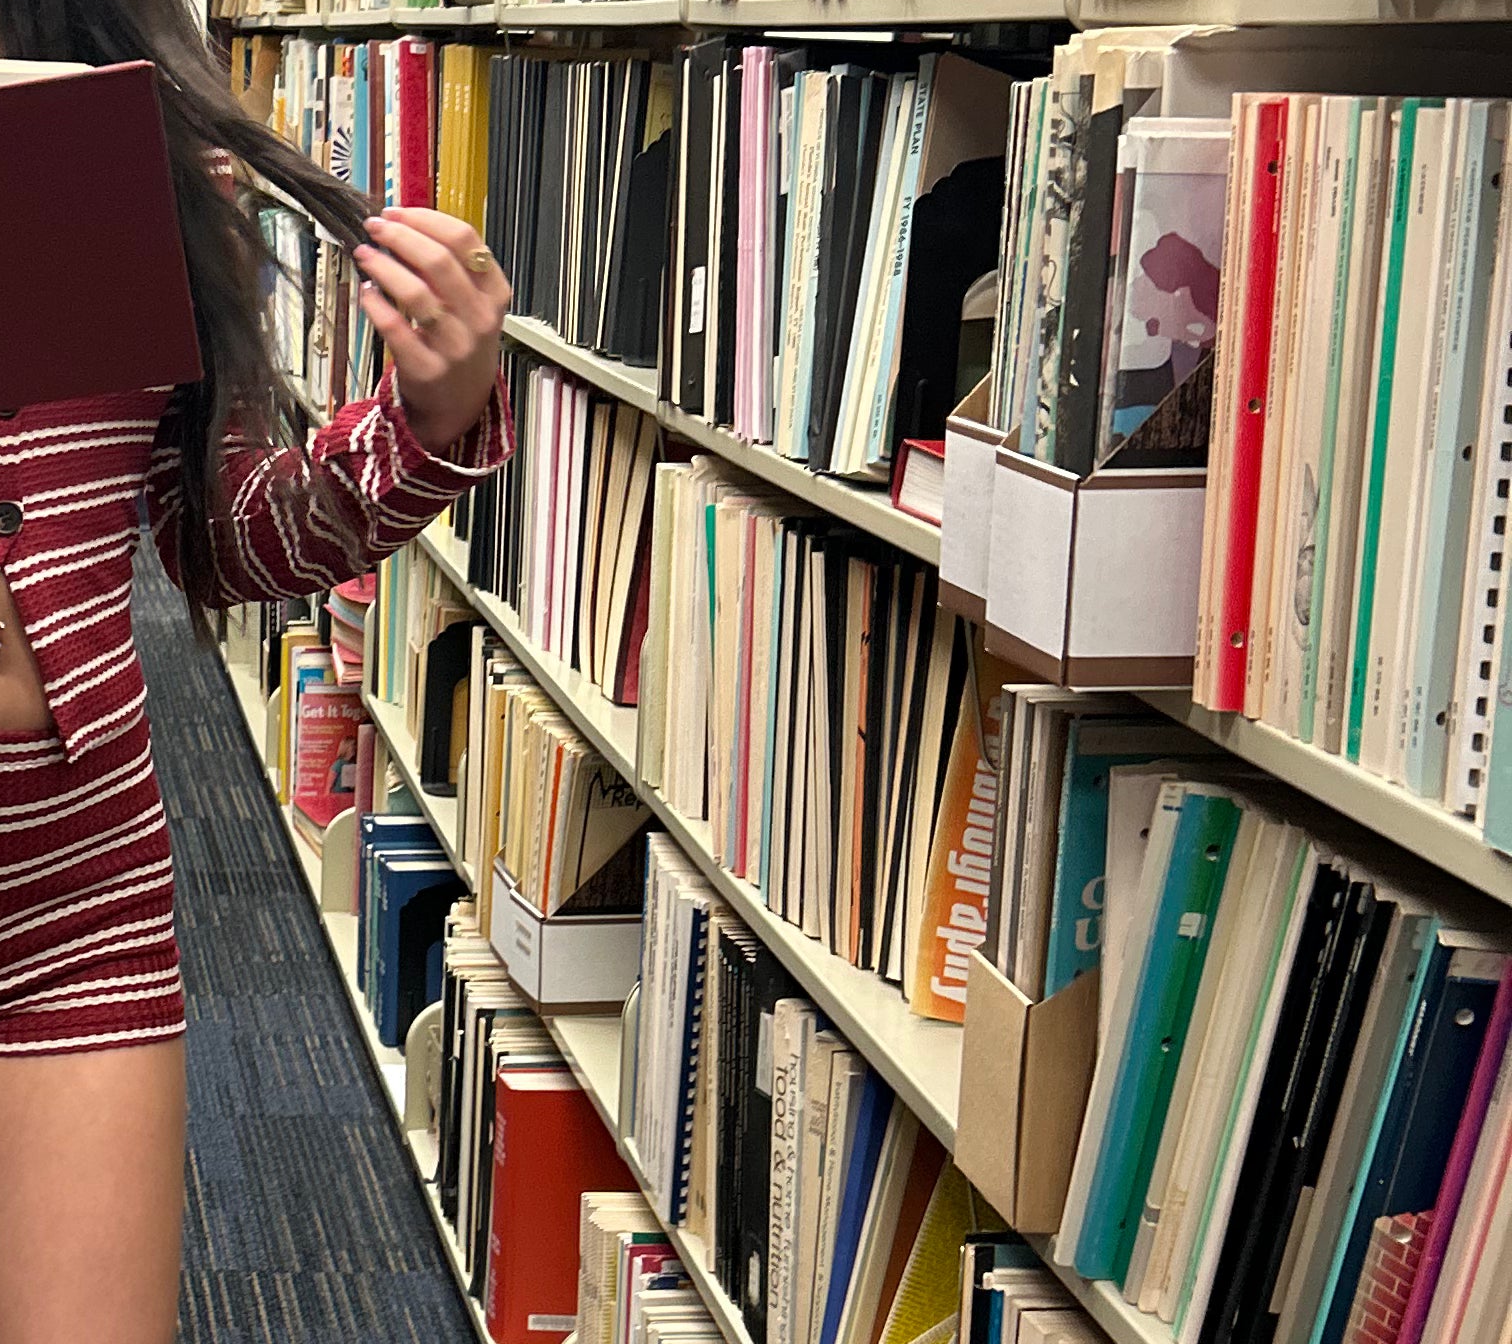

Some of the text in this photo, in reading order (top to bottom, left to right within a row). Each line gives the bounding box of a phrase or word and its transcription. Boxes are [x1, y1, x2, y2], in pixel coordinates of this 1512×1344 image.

[910, 122, 922, 155] PLAN
[301, 704, 363, 722] Get It Tog
[769, 1065, 789, 1309] food & nutrition
